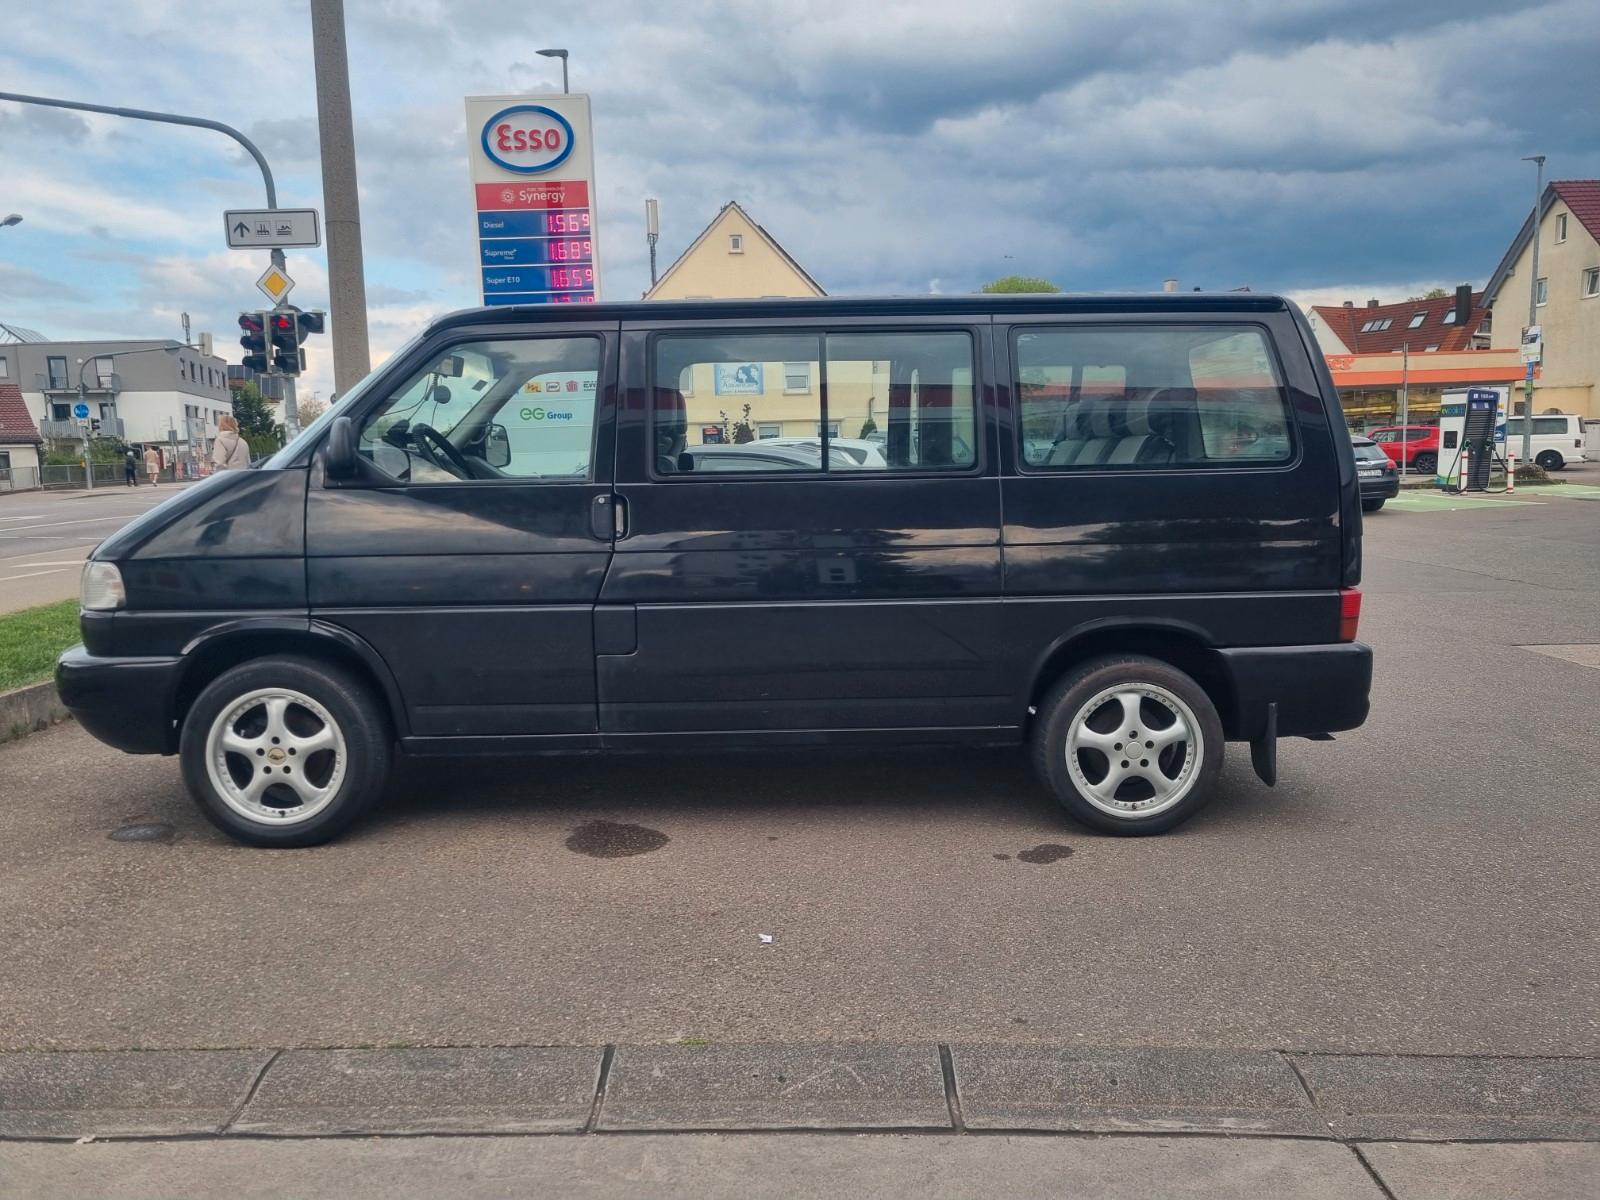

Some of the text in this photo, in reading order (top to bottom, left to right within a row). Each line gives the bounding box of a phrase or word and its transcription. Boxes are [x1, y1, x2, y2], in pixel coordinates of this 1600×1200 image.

[496, 124, 561, 151] Esso
[519, 190, 565, 203] Synergy
[483, 221, 504, 229] Diesel
[507, 276, 520, 284] E10
[547, 411, 573, 421] Group
